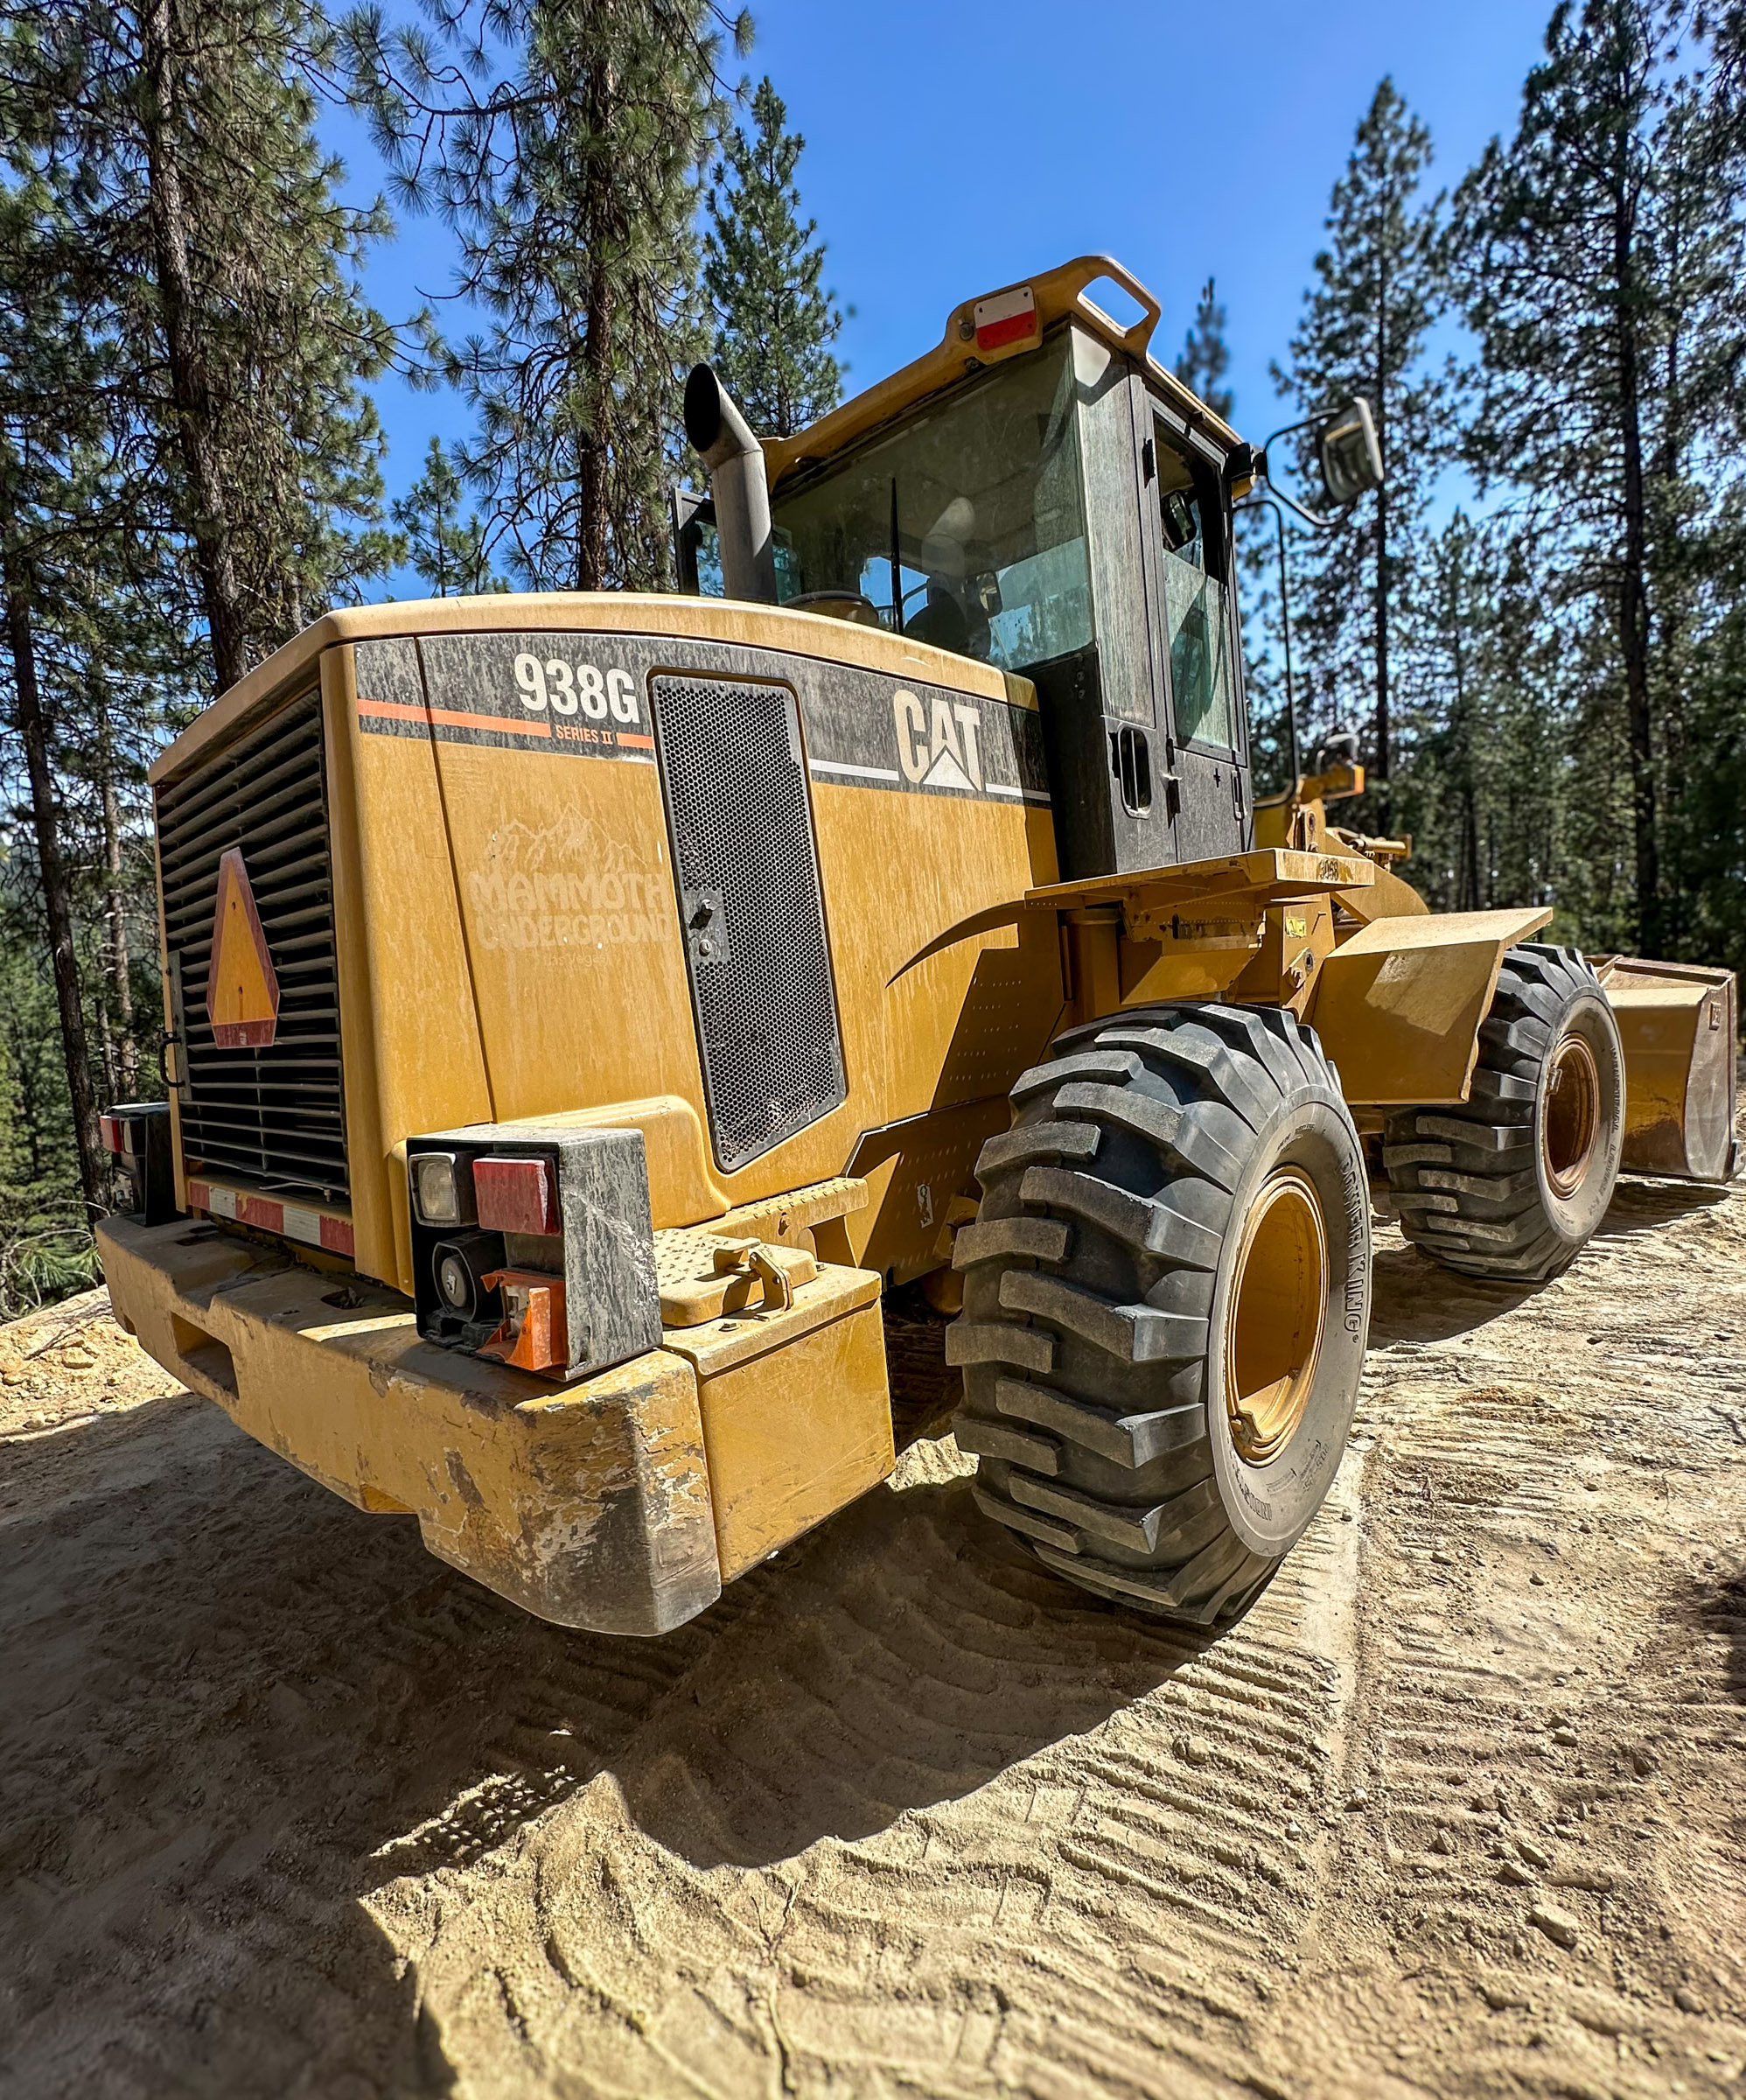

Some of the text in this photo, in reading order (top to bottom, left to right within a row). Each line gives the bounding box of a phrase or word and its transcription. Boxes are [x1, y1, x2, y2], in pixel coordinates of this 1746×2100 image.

[514, 653, 640, 724] 938G
[555, 725, 613, 745] SERIES II
[893, 689, 982, 792] CAT
[469, 870, 671, 914] MAMMOTH
[477, 913, 674, 951] UNDERGROUND
[1344, 1252, 1366, 1333] KING
